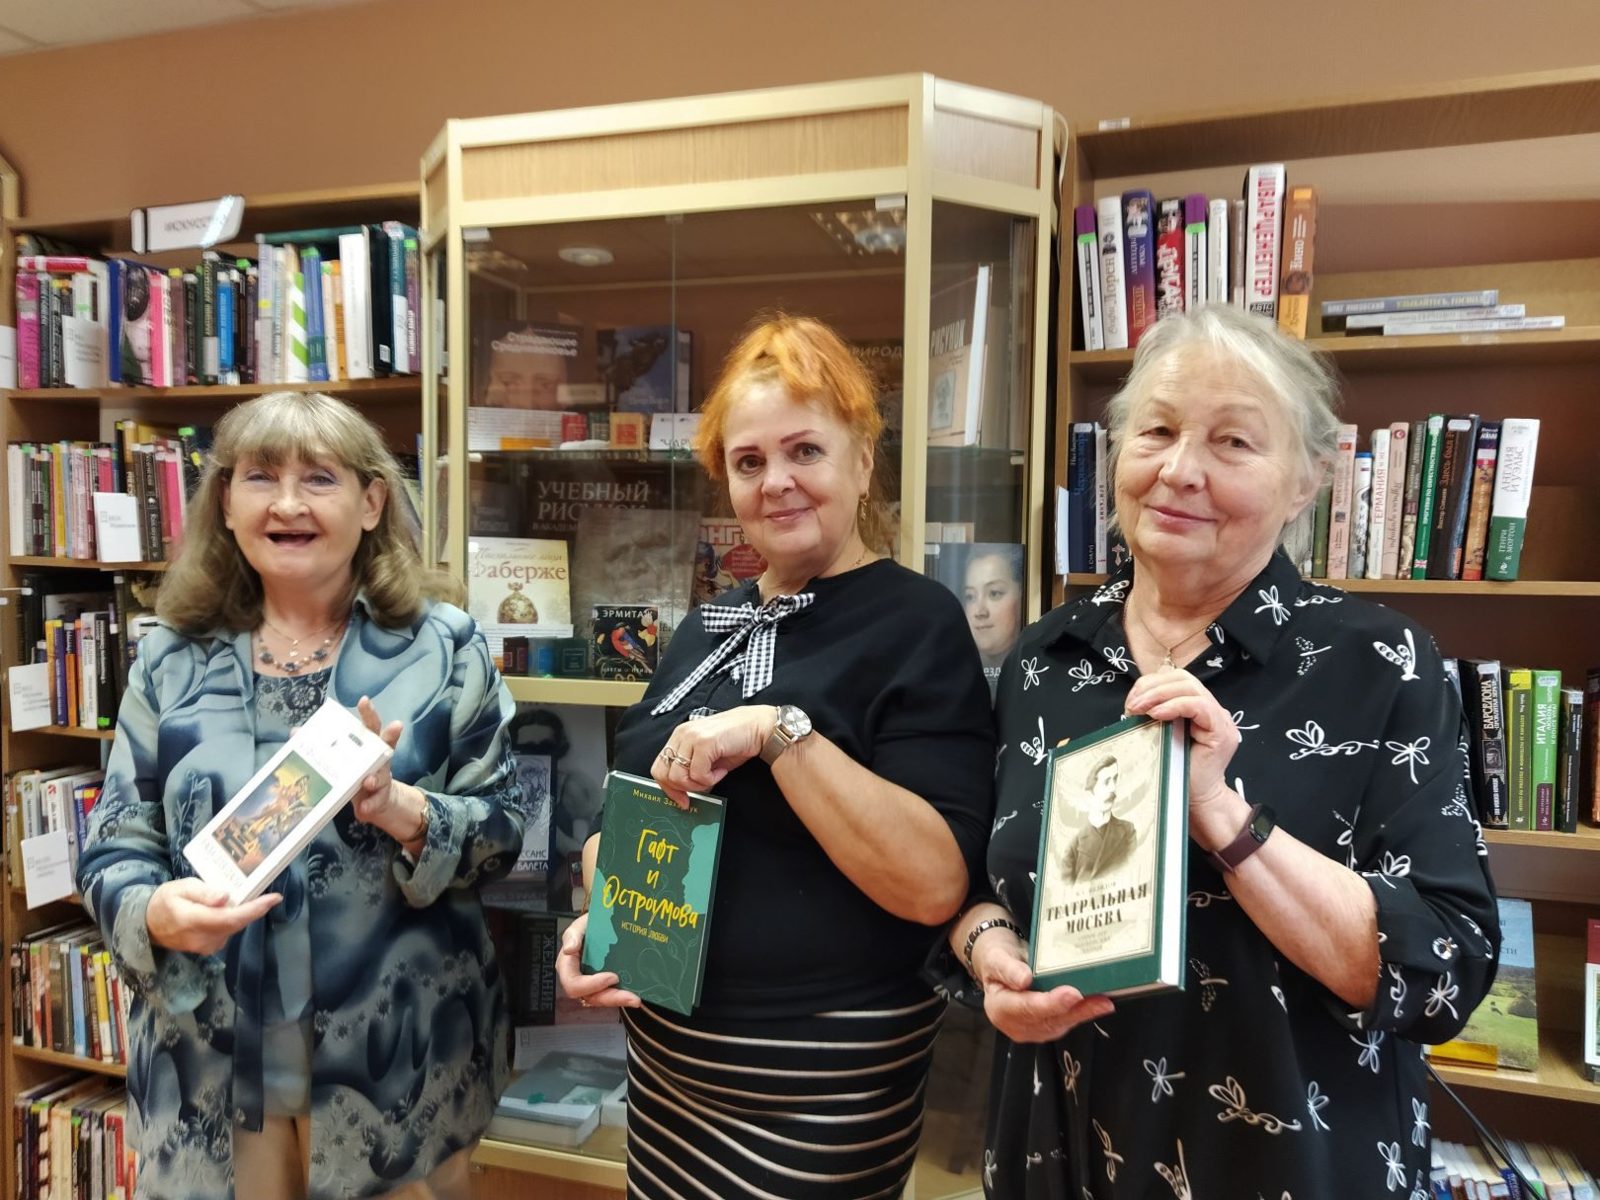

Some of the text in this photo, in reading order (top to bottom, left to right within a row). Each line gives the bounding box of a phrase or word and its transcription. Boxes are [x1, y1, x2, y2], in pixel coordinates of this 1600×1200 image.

[1104, 258, 1119, 304] Лорен
[930, 319, 967, 355] РИСУНОК
[1440, 461, 1451, 486] Здесь
[1502, 446, 1516, 492] АНГЛИЯ
[1512, 447, 1525, 482] УЭЛЬС
[538, 480, 649, 502] УЧЕБНЫЙ
[1373, 469, 1386, 524] ГЕРМАНИЯ
[1499, 529, 1507, 552] ГЕНРИ
[1506, 522, 1516, 553] МОРТОН
[471, 561, 567, 584] Фаберже
[602, 609, 653, 619] ЭРМИТАЖ
[1482, 680, 1494, 729] БАРСЕЛОНА
[1537, 704, 1546, 744] ИТАЛИЯ
[633, 788, 661, 804] Михаил
[521, 849, 547, 859] ССАНС
[636, 828, 680, 864] Гафт
[518, 861, 548, 871] БАЛЕТА
[647, 869, 659, 889] и
[603, 875, 698, 929] Остроумова
[1047, 883, 1148, 922] ТЕАТРАЛЬНАЯ
[621, 920, 669, 944] ИСТОРИЯ ЛЮБВИ
[1067, 908, 1122, 933] МОСКВА
[542, 935, 554, 1011] ЖЕЛАНИЕ
